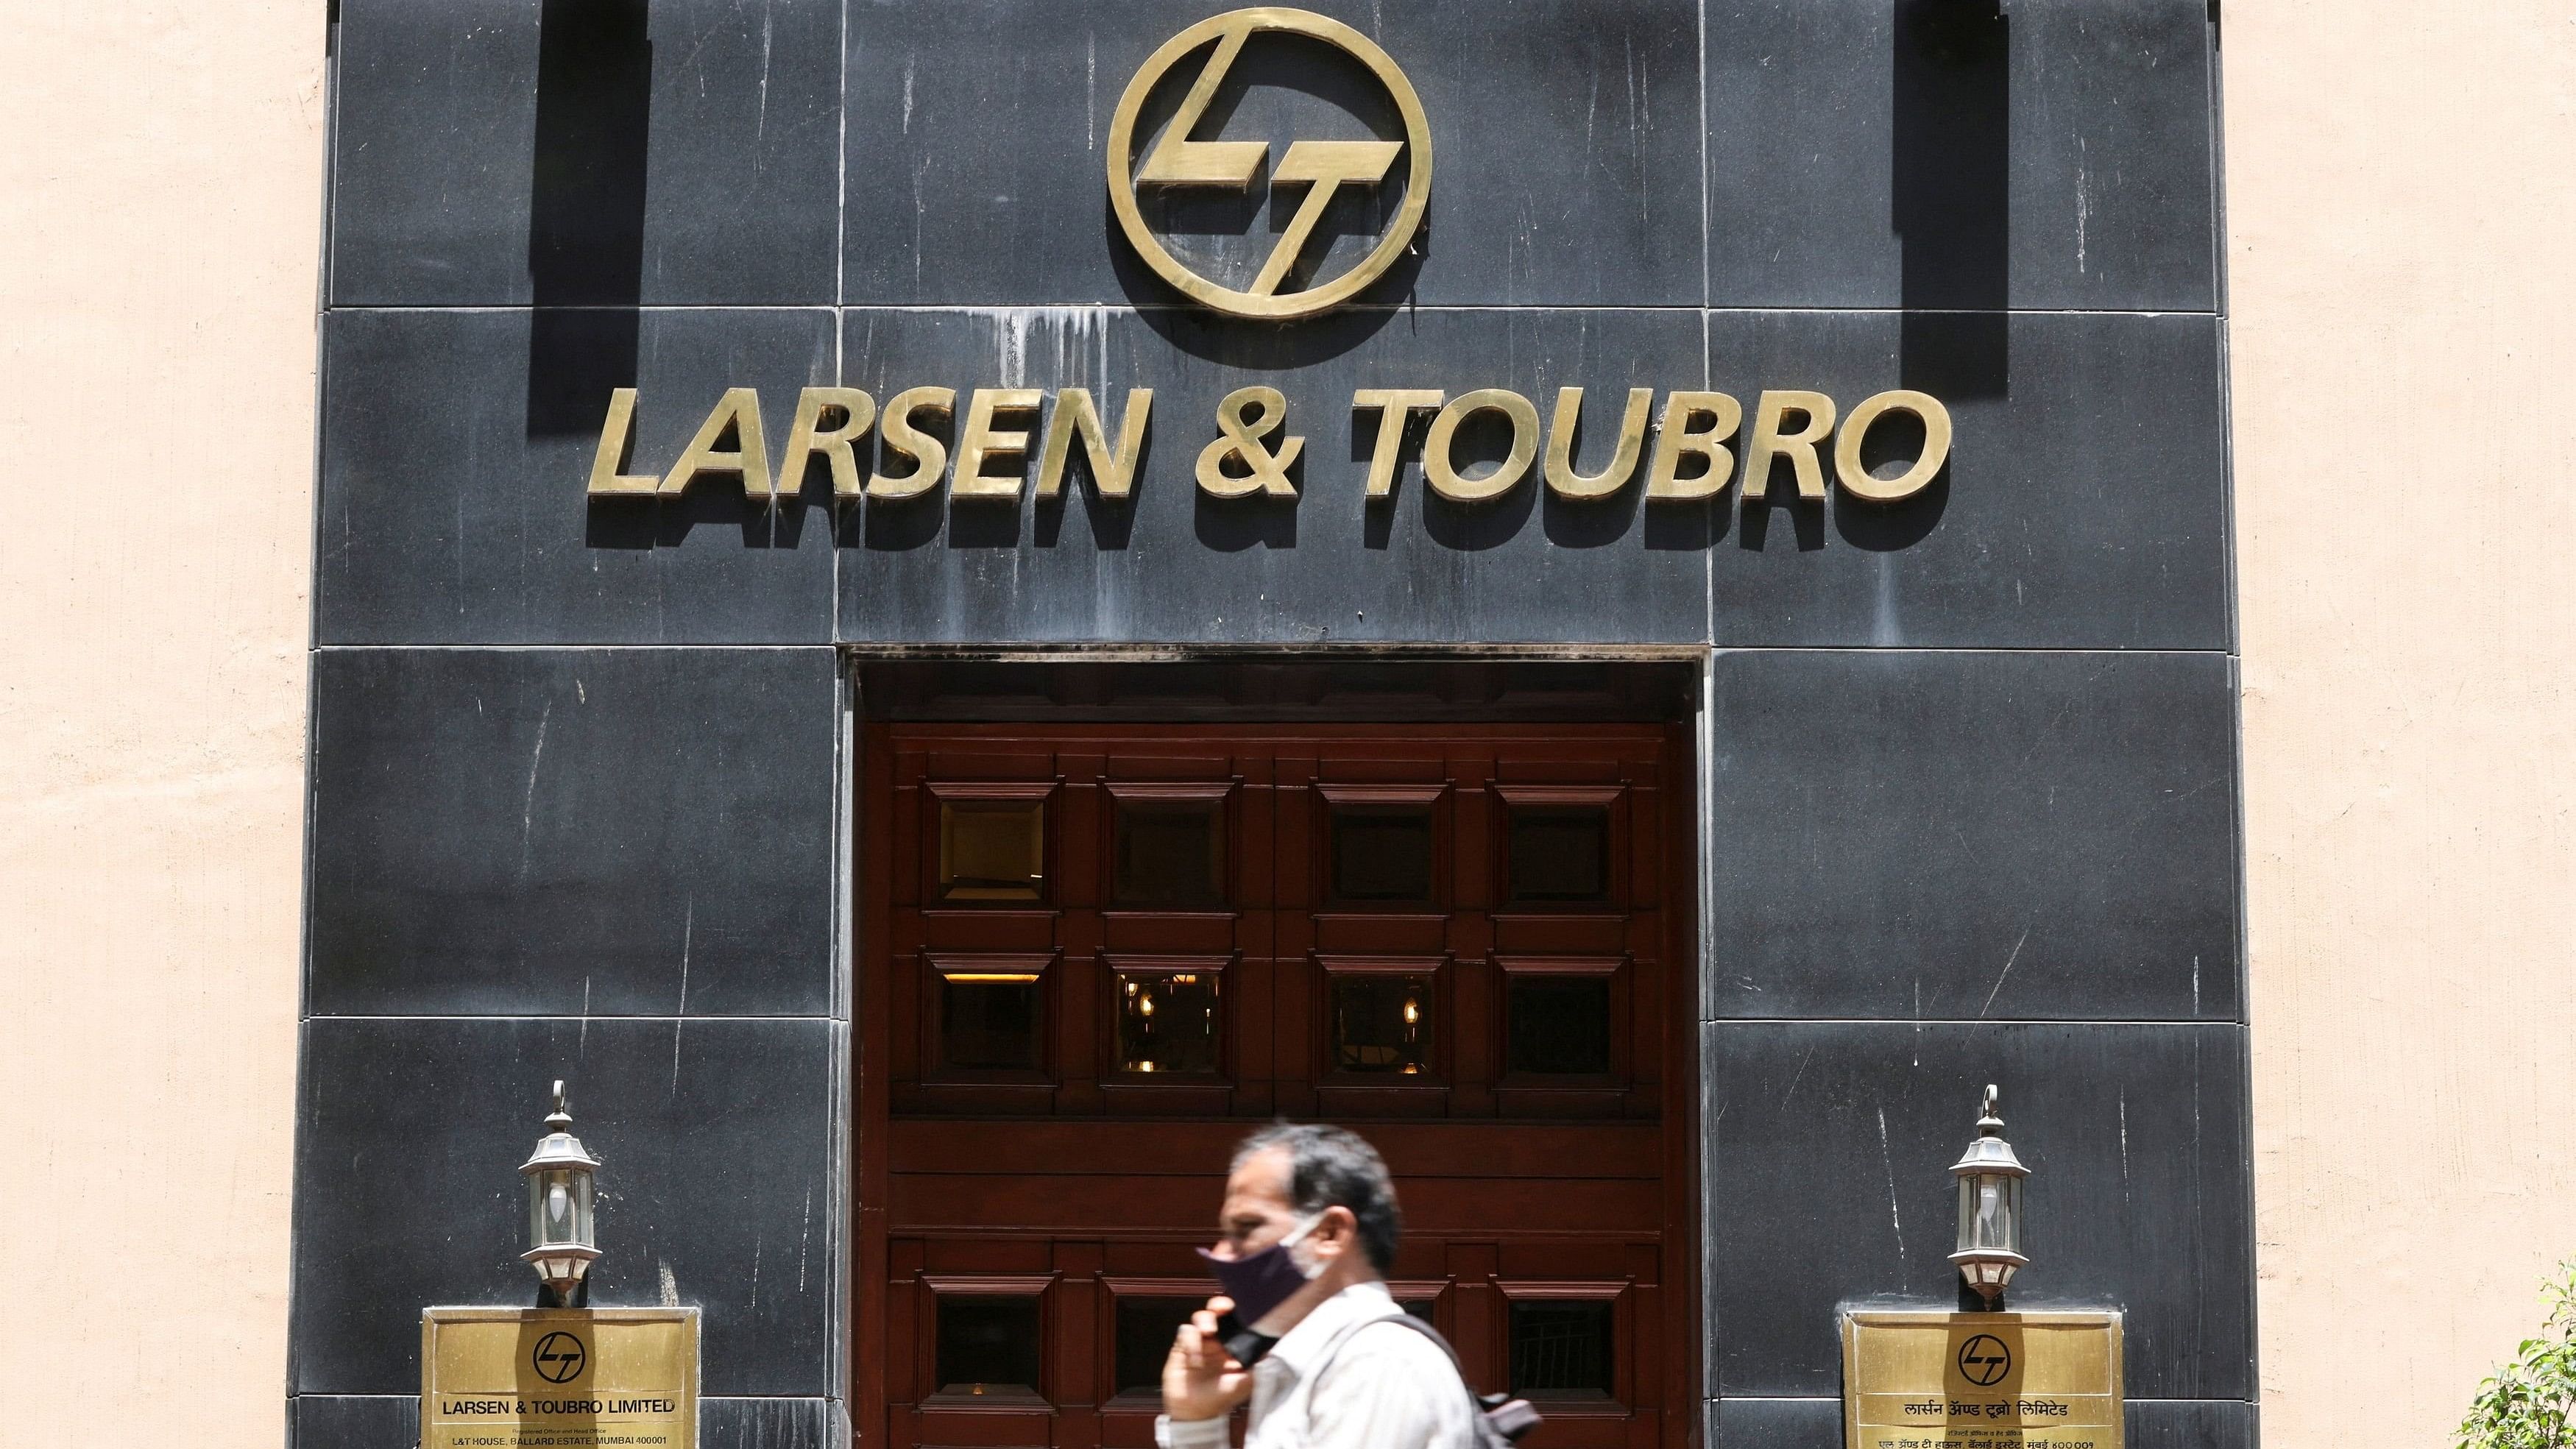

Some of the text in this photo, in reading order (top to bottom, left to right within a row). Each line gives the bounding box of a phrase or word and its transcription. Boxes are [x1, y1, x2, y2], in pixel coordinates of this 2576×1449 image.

[587, 386, 1953, 500] LARSEN & TOUBRO
[442, 1399, 676, 1415] LARSEN & TOUBRO LIMITED
[1904, 1399, 1944, 1415] लार्सन
[1985, 1399, 2011, 1419] टूब्रो
[2016, 1400, 2069, 1416] लिमिटेड
[452, 1437, 470, 1445] L&T
[473, 1437, 508, 1446] HOUSE,
[510, 1437, 554, 1445] BALLARD
[595, 1436, 634, 1445] MUMBAI
[635, 1436, 667, 1445] 400001
